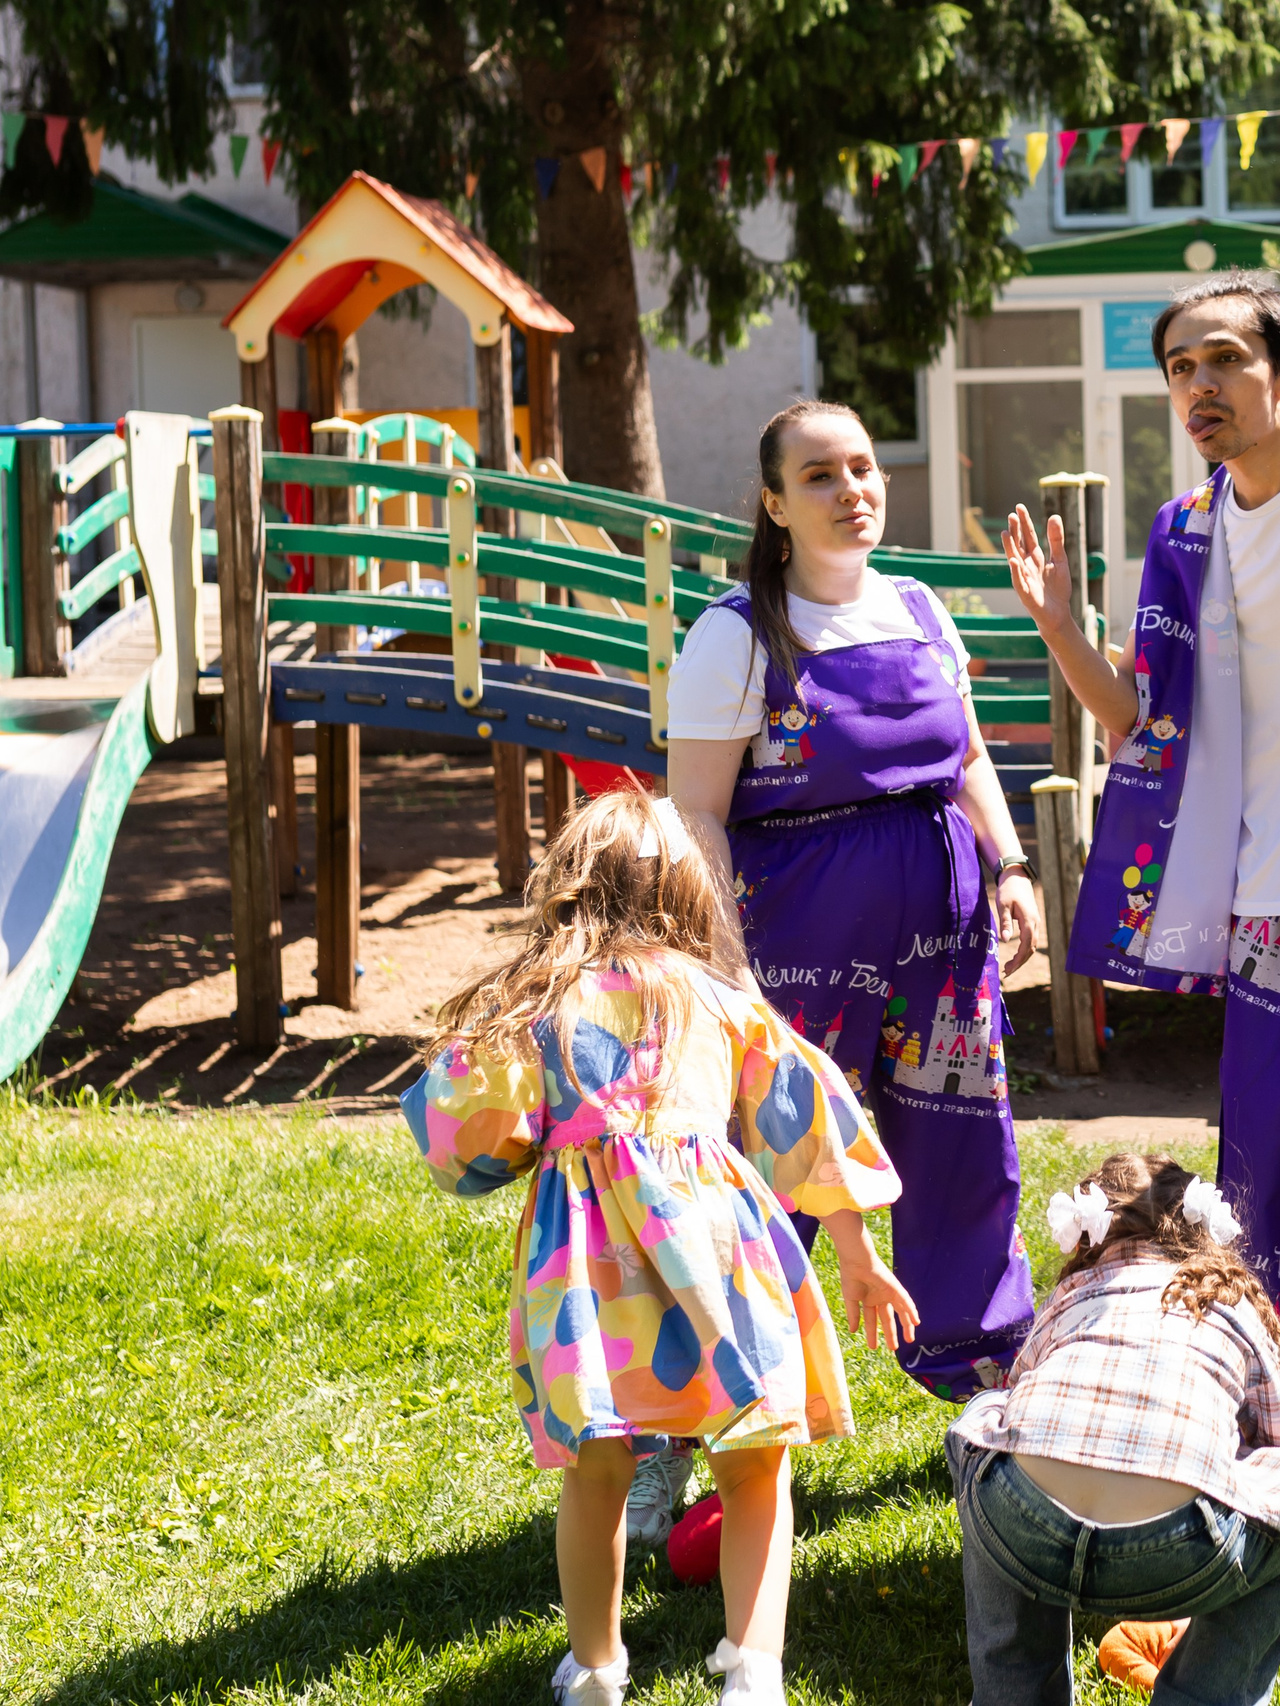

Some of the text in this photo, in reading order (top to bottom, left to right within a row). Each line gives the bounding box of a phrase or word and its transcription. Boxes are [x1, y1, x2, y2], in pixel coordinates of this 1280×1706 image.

[1136, 604, 1197, 650] Болик
[897, 934, 963, 965] Лёлик
[969, 931, 979, 948] и
[753, 957, 822, 988] Лёлик
[828, 968, 843, 986] и
[882, 1085, 1008, 1119] агентство праздников
